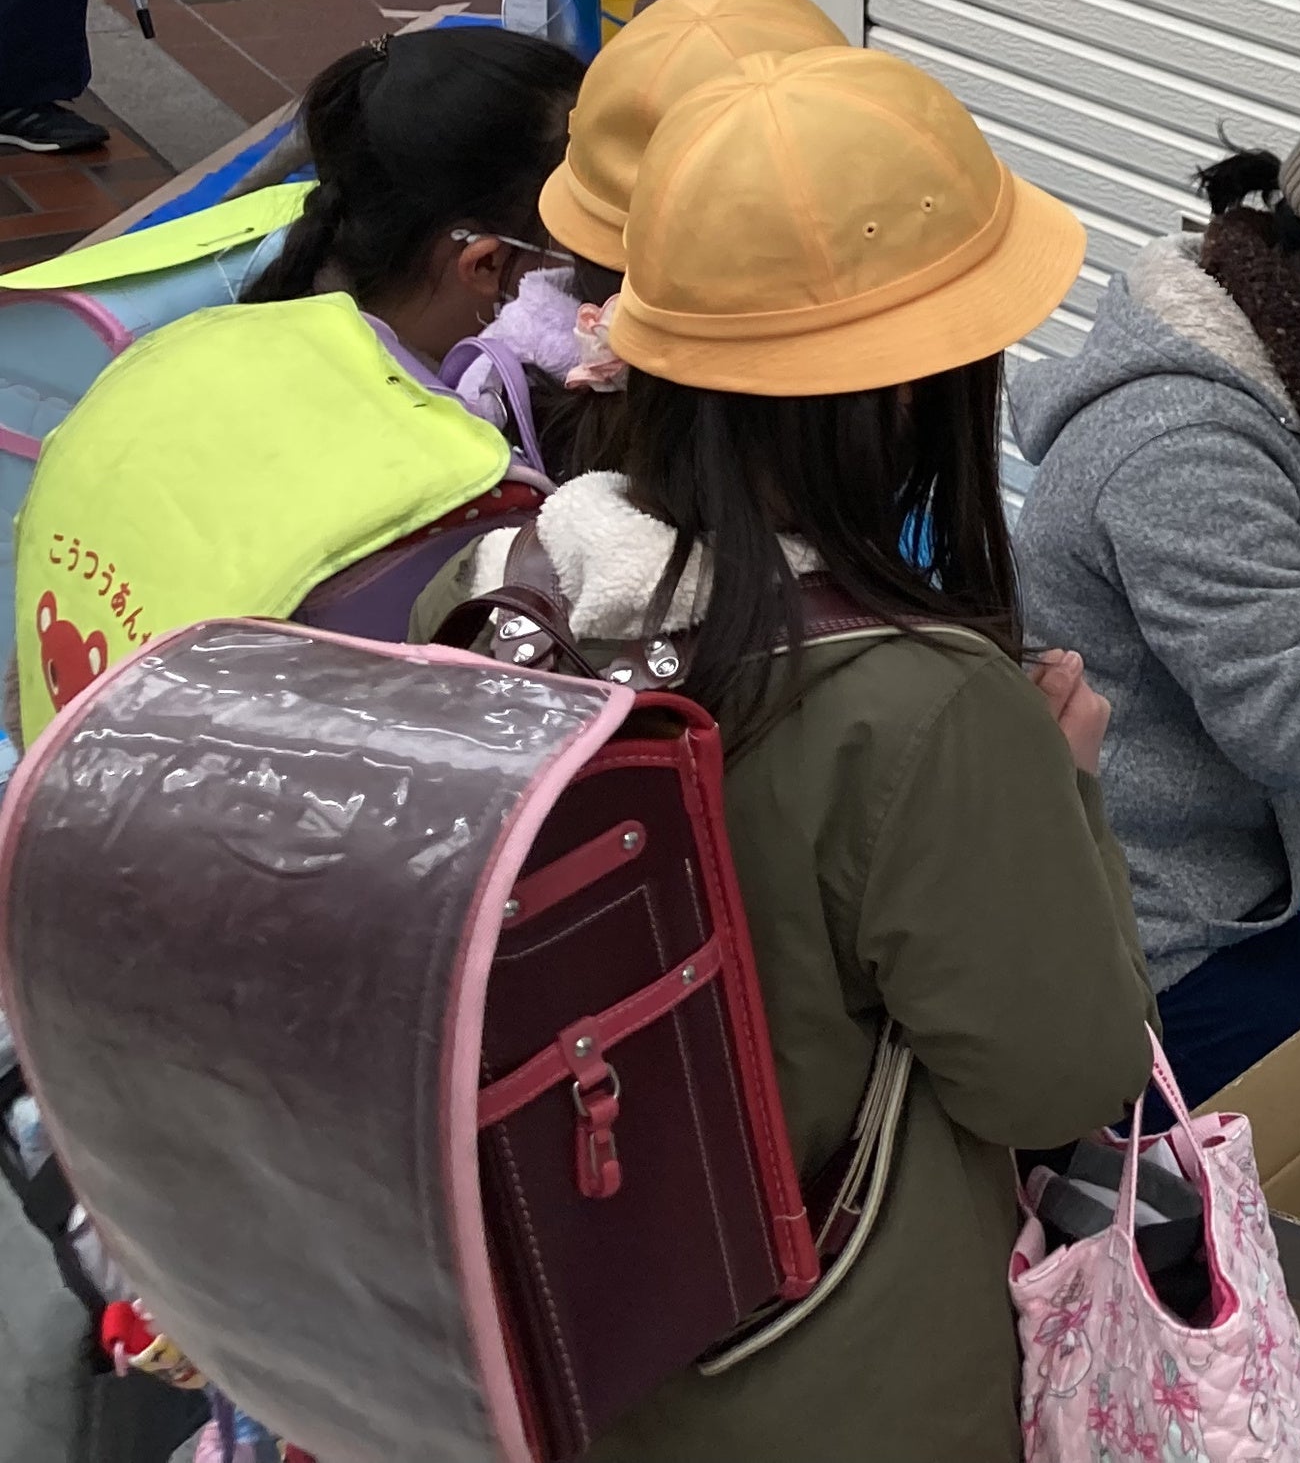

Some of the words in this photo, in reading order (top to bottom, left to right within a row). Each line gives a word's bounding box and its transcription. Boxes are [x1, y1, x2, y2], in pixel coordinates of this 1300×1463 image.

[49, 533, 152, 646] こうつうあん
